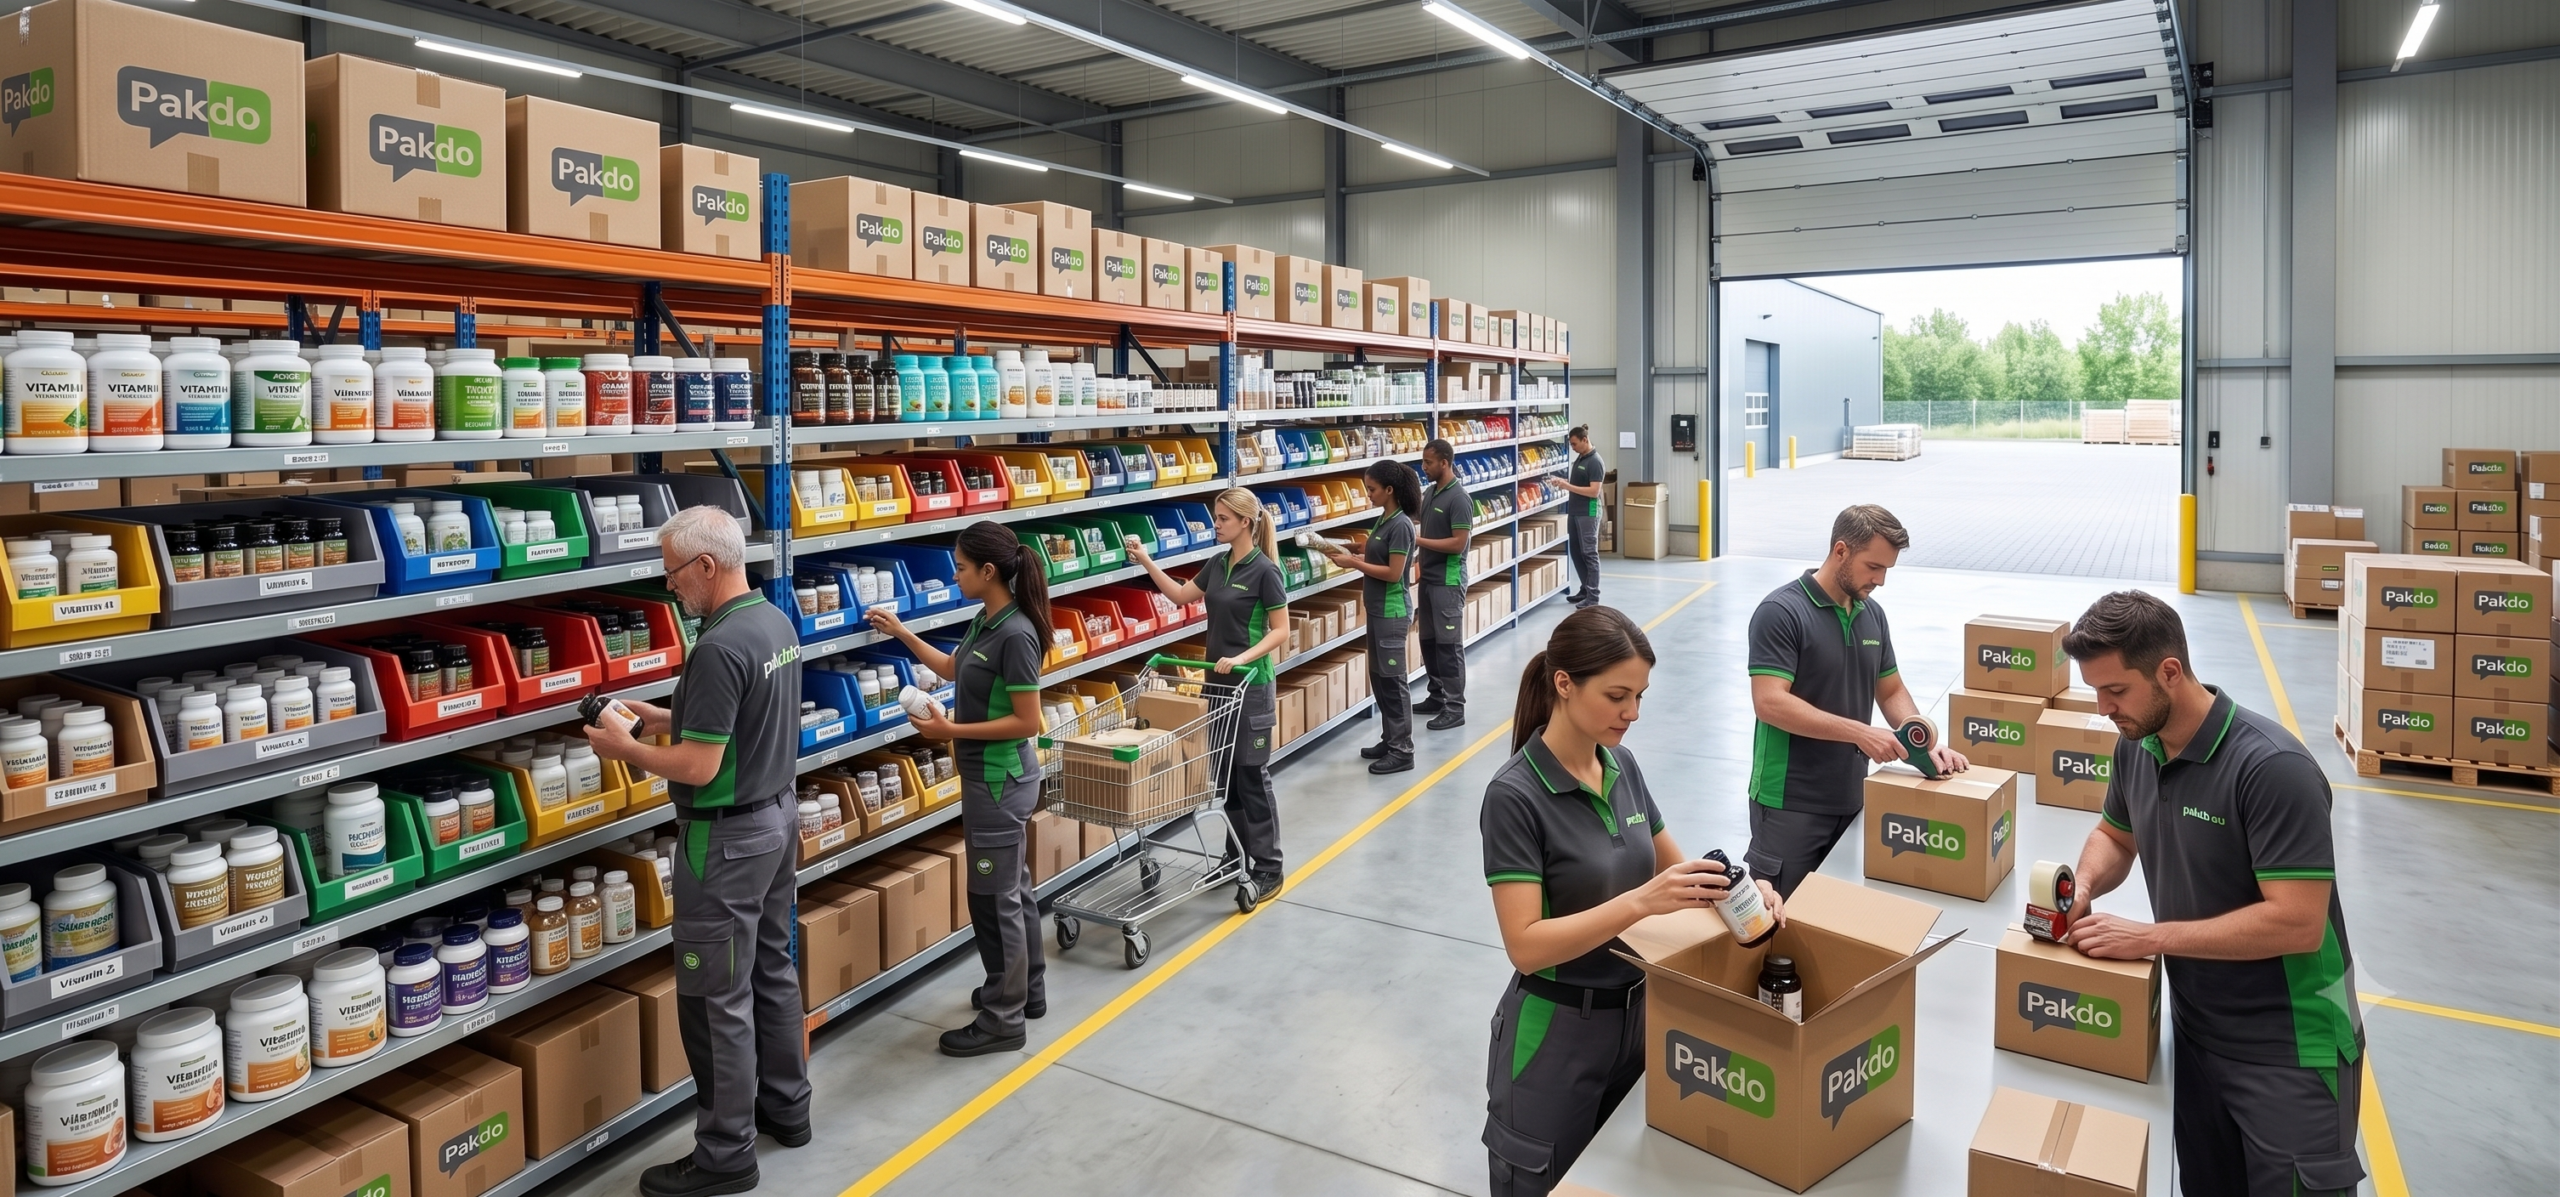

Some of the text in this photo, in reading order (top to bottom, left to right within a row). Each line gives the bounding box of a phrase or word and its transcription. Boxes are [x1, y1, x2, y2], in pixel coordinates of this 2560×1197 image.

[5, 79, 50, 113] Pakdo
[130, 81, 260, 131] Pakdo
[379, 126, 473, 167] Pakdo
[558, 157, 634, 192] Pakdo
[697, 193, 746, 216] Pakdo
[860, 219, 900, 239] Pakdo
[926, 231, 961, 249] Pakdo
[989, 240, 1027, 259] Pakdo
[2386, 591, 2434, 605] Pakdo
[2478, 595, 2529, 609] Pakdo
[1982, 648, 2032, 669] Pakdo
[2477, 659, 2528, 674] Pakdo
[2382, 713, 2430, 728] Pakdo
[2476, 722, 2526, 737] Pakdo
[1968, 721, 2020, 742] Pakdo
[2059, 756, 2110, 777] Pakd
[1887, 821, 1959, 854] Pakdo
[2027, 991, 2112, 1029] Pakdo
[1674, 1042, 1766, 1103] Pakdo
[1828, 1042, 1896, 1105] Pakdo
[445, 1123, 503, 1164] Pakdo
